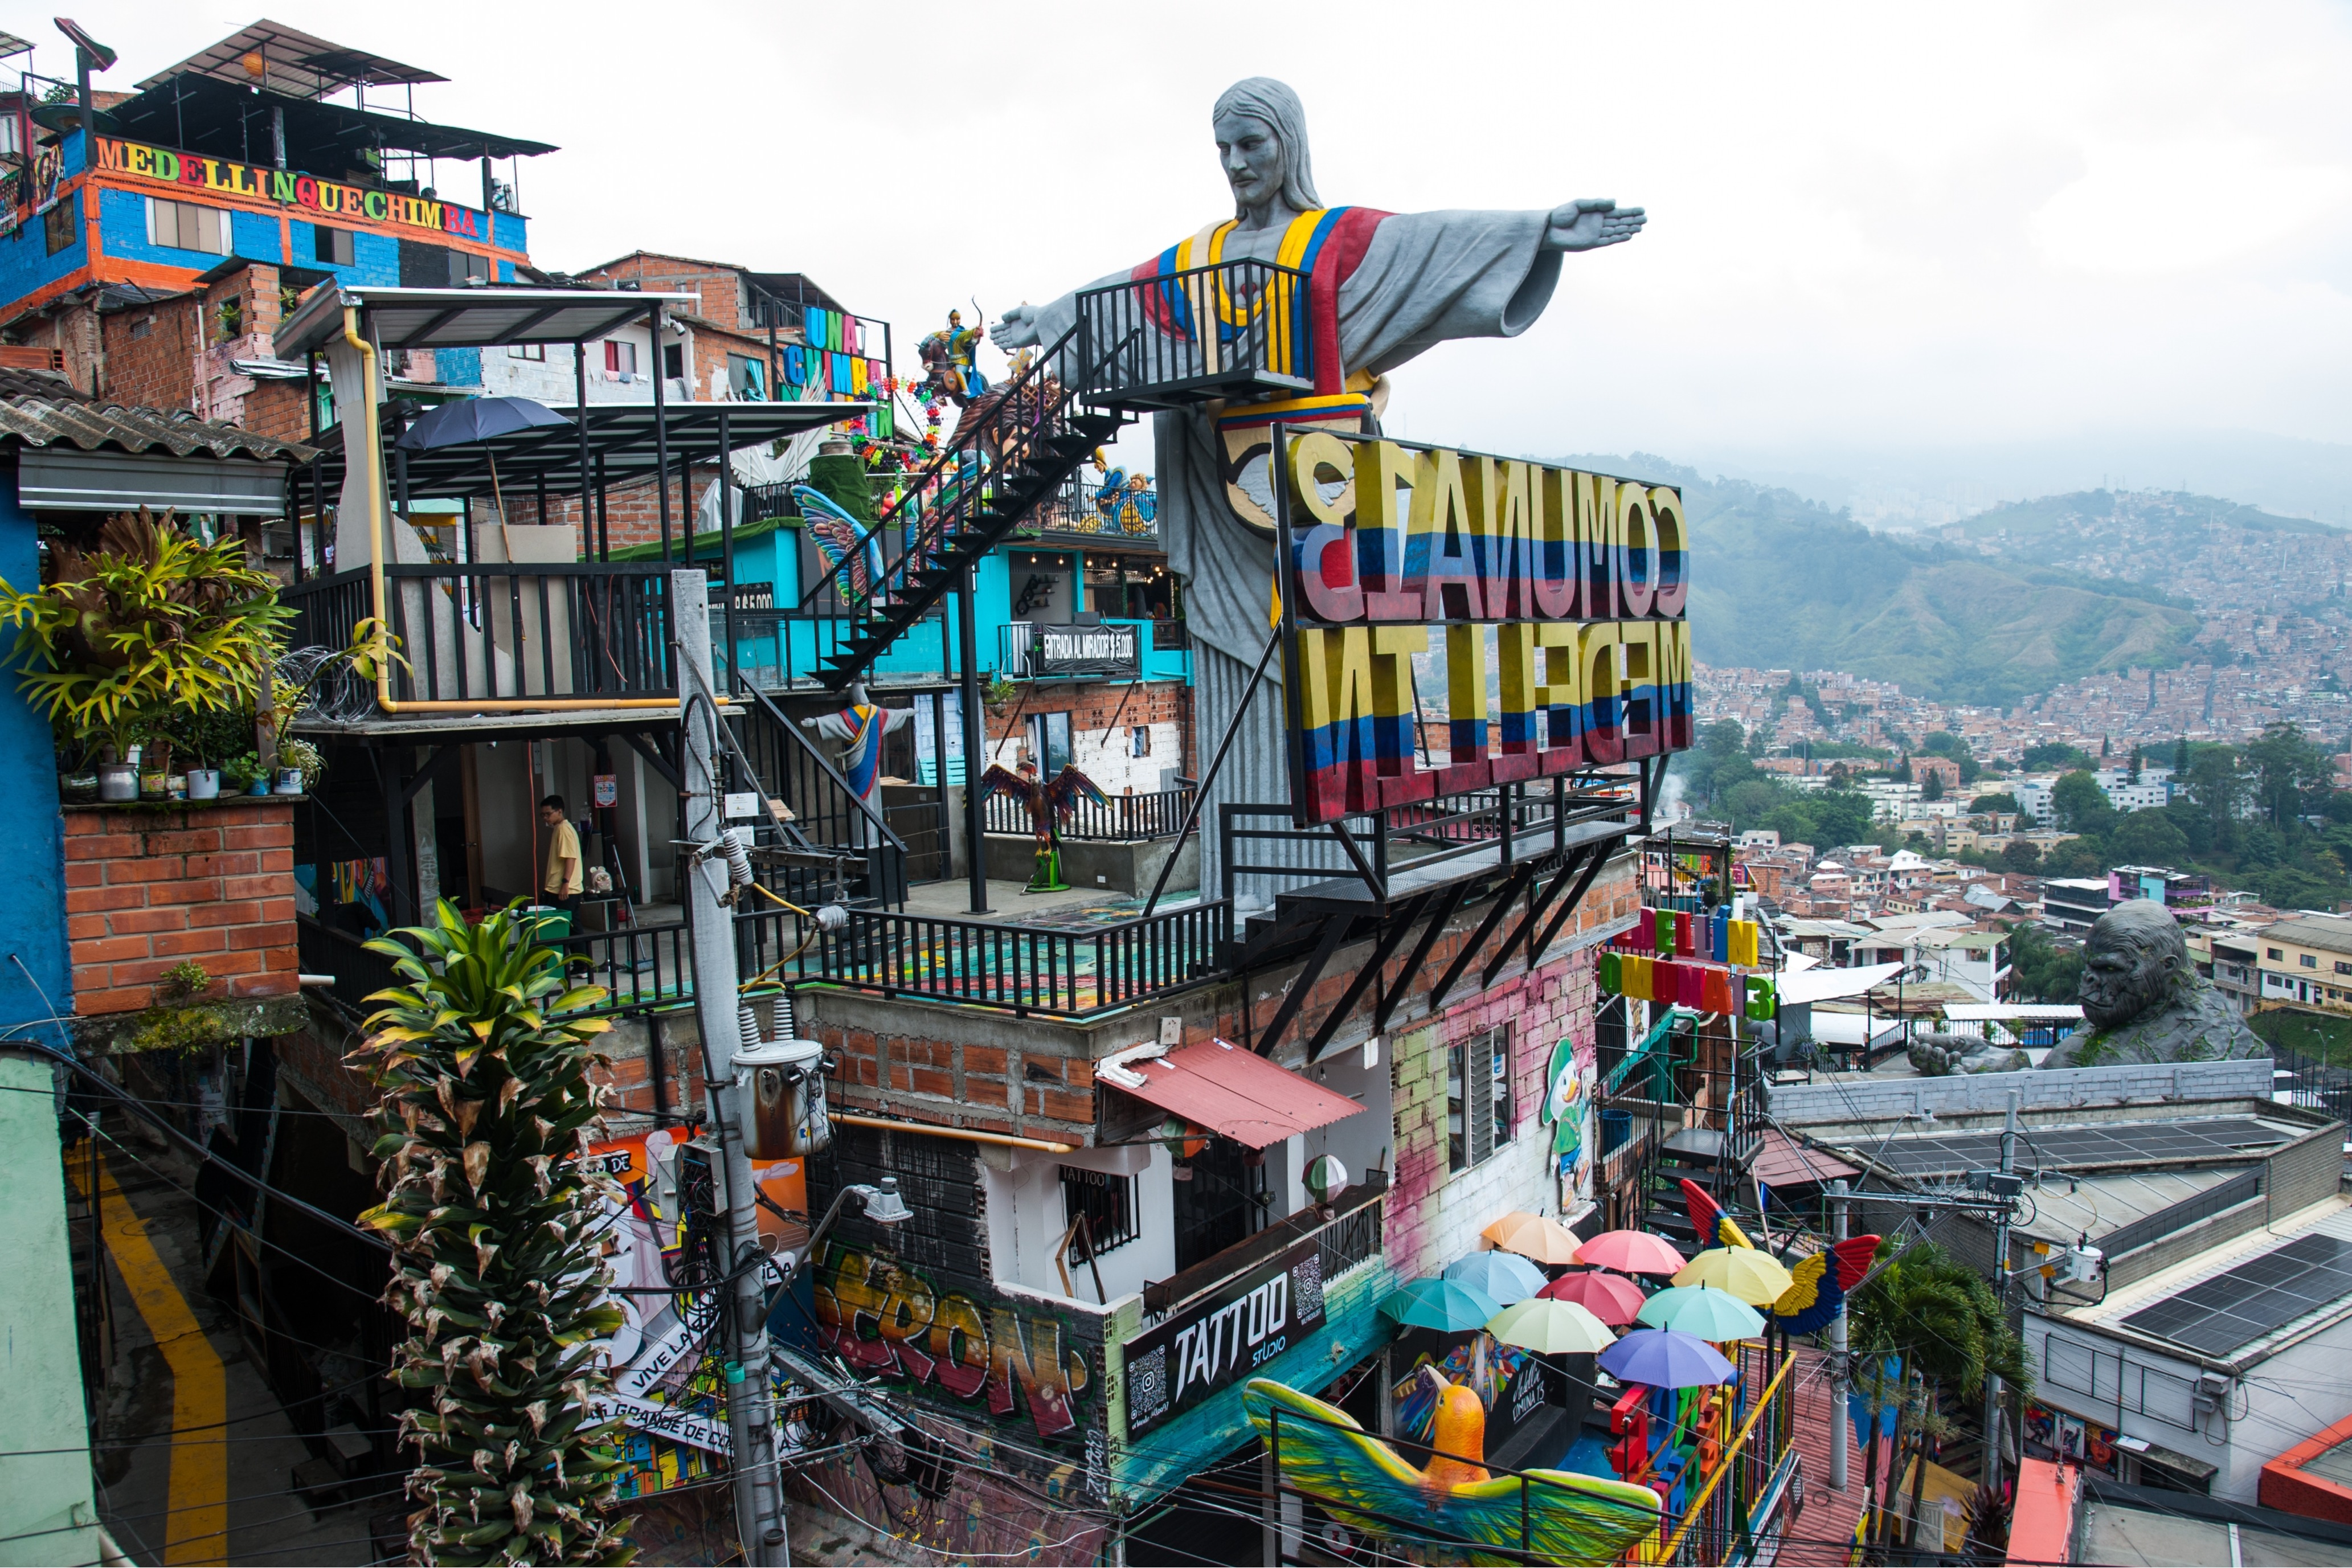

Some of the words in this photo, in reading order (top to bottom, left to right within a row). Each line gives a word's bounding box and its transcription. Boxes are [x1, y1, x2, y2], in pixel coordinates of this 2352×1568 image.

[805, 306, 859, 355] UNA
[782, 345, 885, 399] CHIMBA
[1044, 634, 1074, 660] ENTRADA
[1074, 634, 1082, 659] AL
[1082, 633, 1110, 659] MIRADOR
[1110, 632, 1115, 661] $
[611, 1155, 630, 1173] DE
[1061, 1165, 1105, 1186] TATTOO
[1175, 1271, 1287, 1404] TATTOO
[1252, 1335, 1286, 1368] STUDIO
[631, 1351, 672, 1389] VIVE
[669, 1332, 694, 1355] LA
[1512, 1390, 1536, 1422] COMUNA
[1536, 1379, 1545, 1402] 13
[683, 1424, 709, 1442] DE
